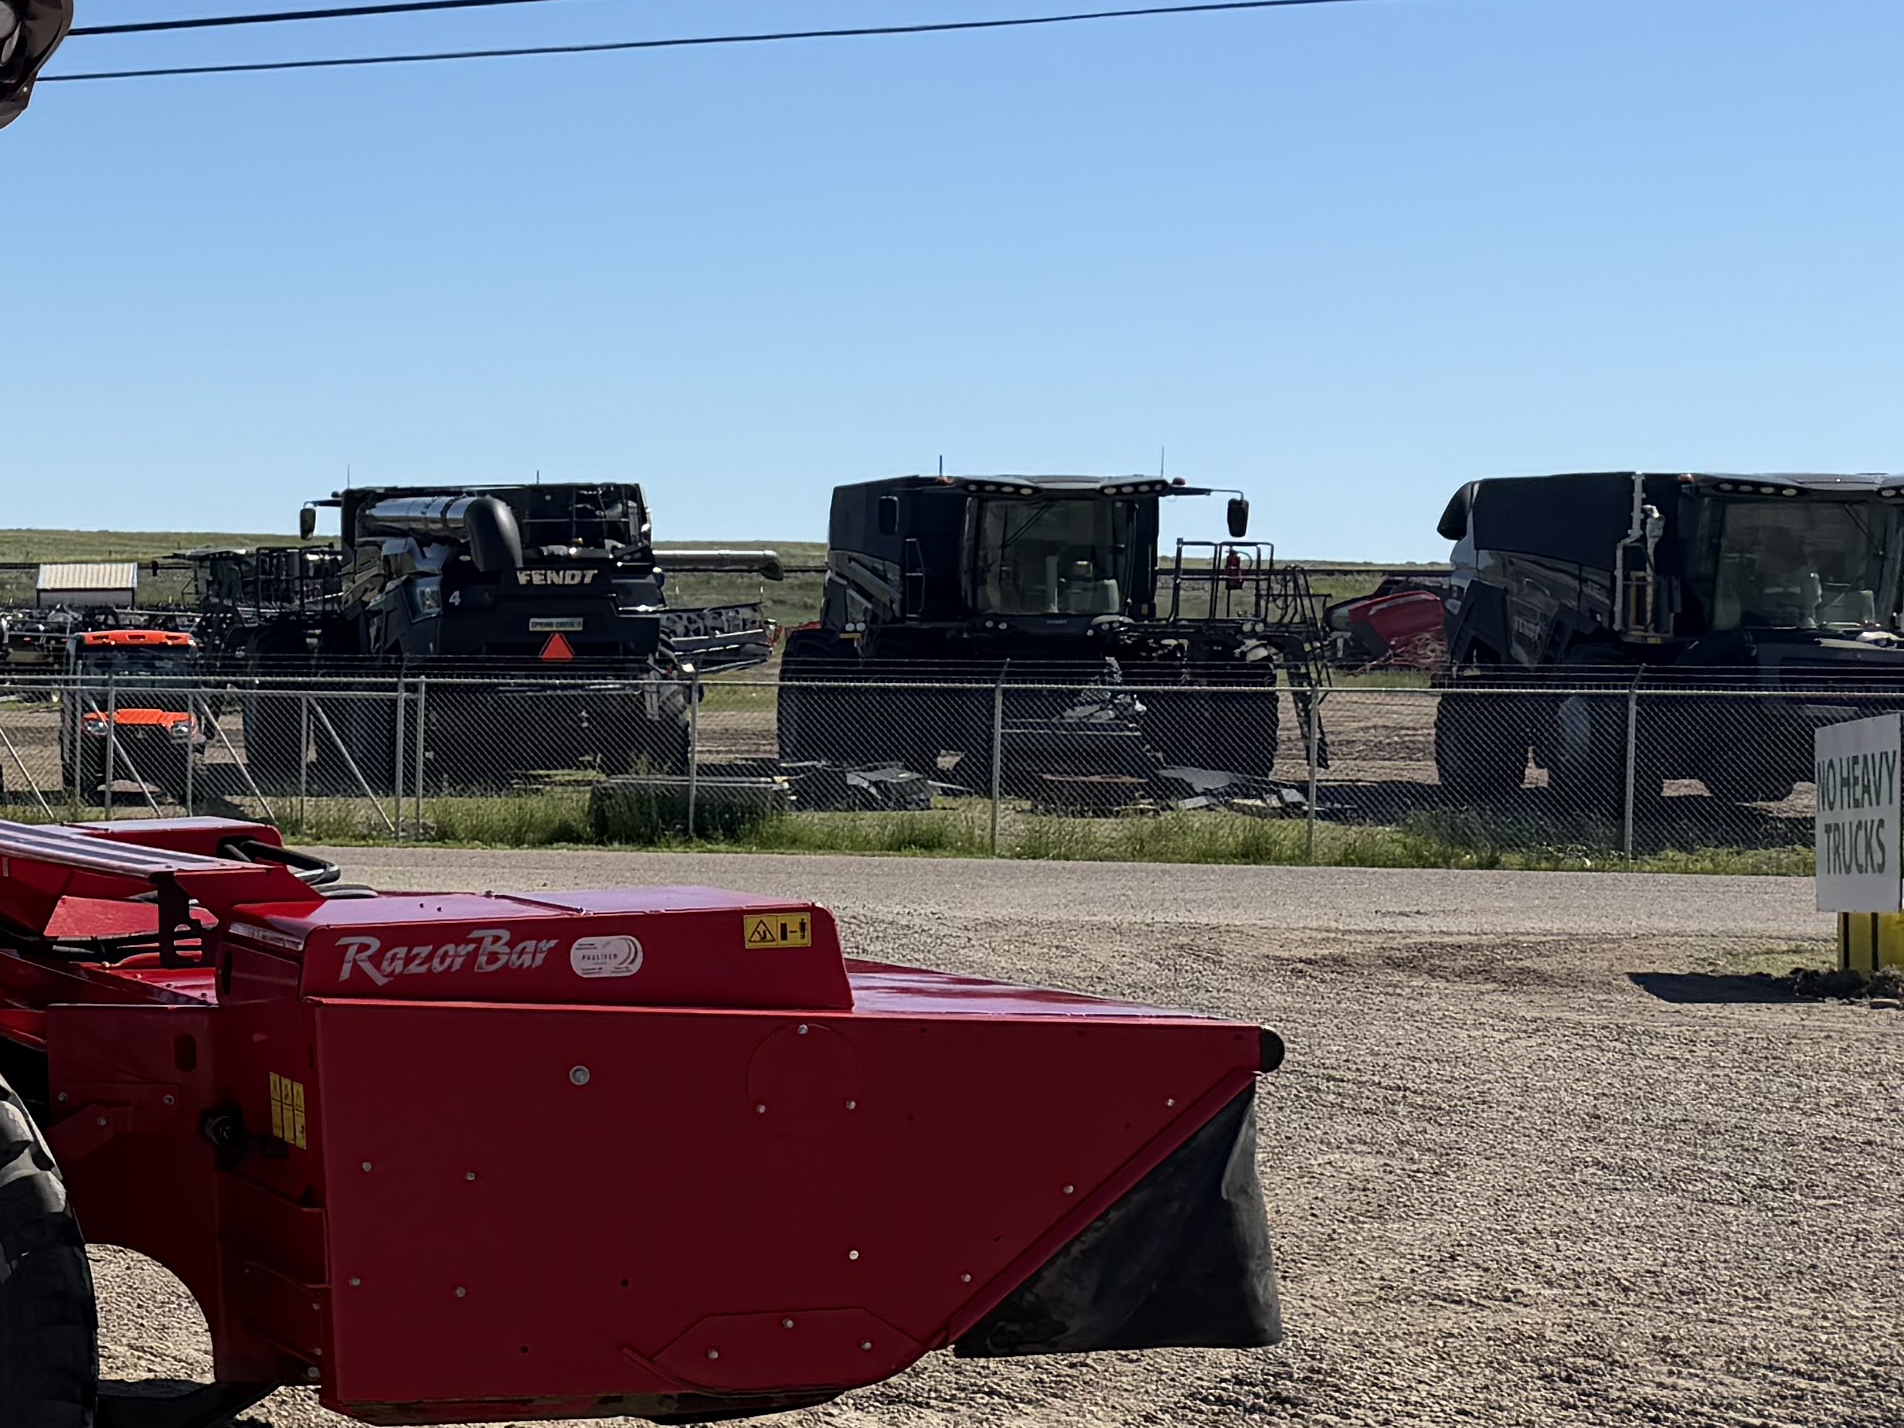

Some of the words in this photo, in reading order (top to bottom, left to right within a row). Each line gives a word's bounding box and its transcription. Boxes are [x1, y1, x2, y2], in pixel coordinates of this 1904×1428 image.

[516, 570, 598, 585] FENDT
[448, 590, 462, 606] 4
[1817, 758, 1837, 812] NO
[1839, 750, 1897, 810] HEAVY
[1824, 818, 1886, 876] TRUCKS
